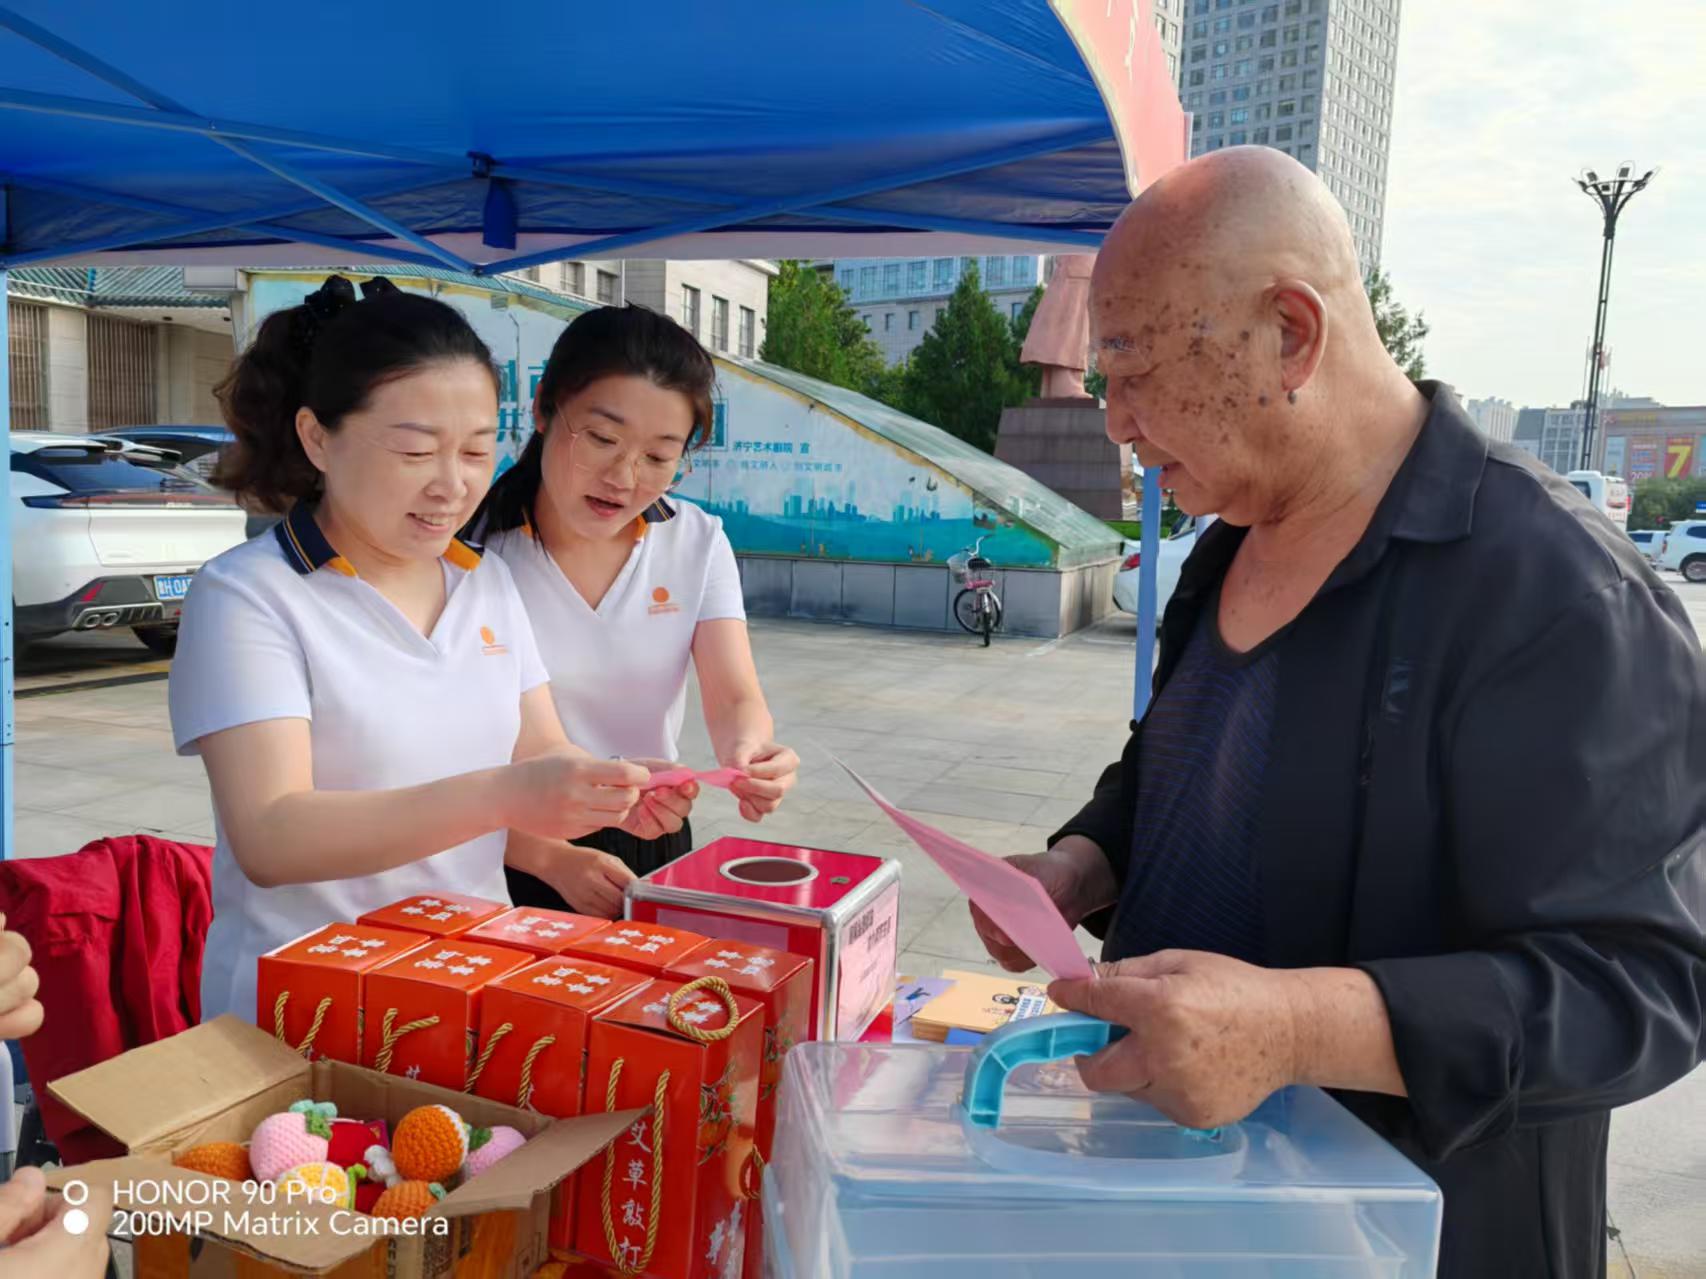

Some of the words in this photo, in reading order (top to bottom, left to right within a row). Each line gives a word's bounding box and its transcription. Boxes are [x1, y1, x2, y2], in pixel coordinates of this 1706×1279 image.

[1667, 445, 1692, 479] 7
[618, 1120, 652, 1268] 艾草敲打
